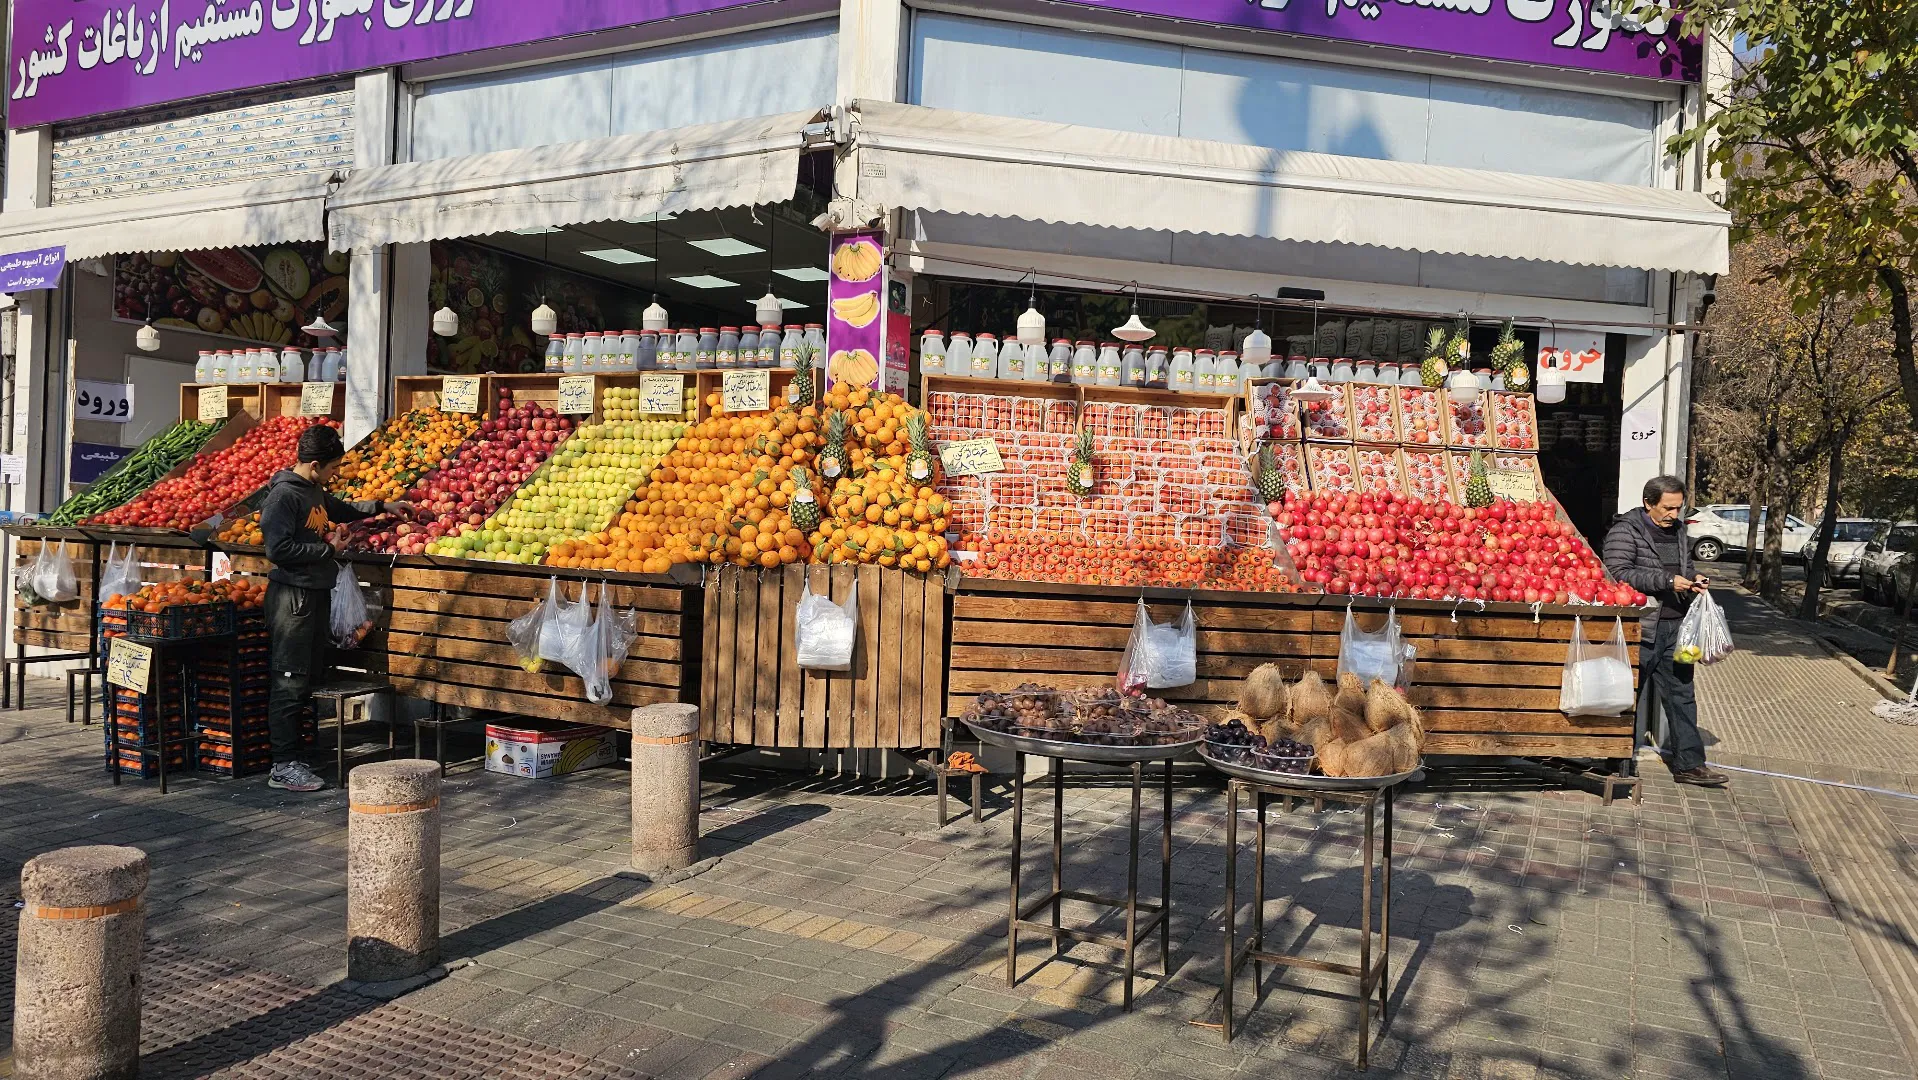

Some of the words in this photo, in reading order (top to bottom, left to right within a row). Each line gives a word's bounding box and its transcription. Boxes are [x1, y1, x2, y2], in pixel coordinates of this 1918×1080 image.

[78, 3, 144, 75] باغات
[174, 0, 263, 69] مستقیم
[11, 18, 74, 100] کشور
[43, 252, 60, 266] انواع
[7, 276, 23, 287] است
[23, 276, 45, 286] موجود
[1540, 341, 1602, 371] خروج
[78, 390, 130, 416] ورود
[1631, 426, 1656, 440] خروج
[81, 451, 120, 462] طبیعی
